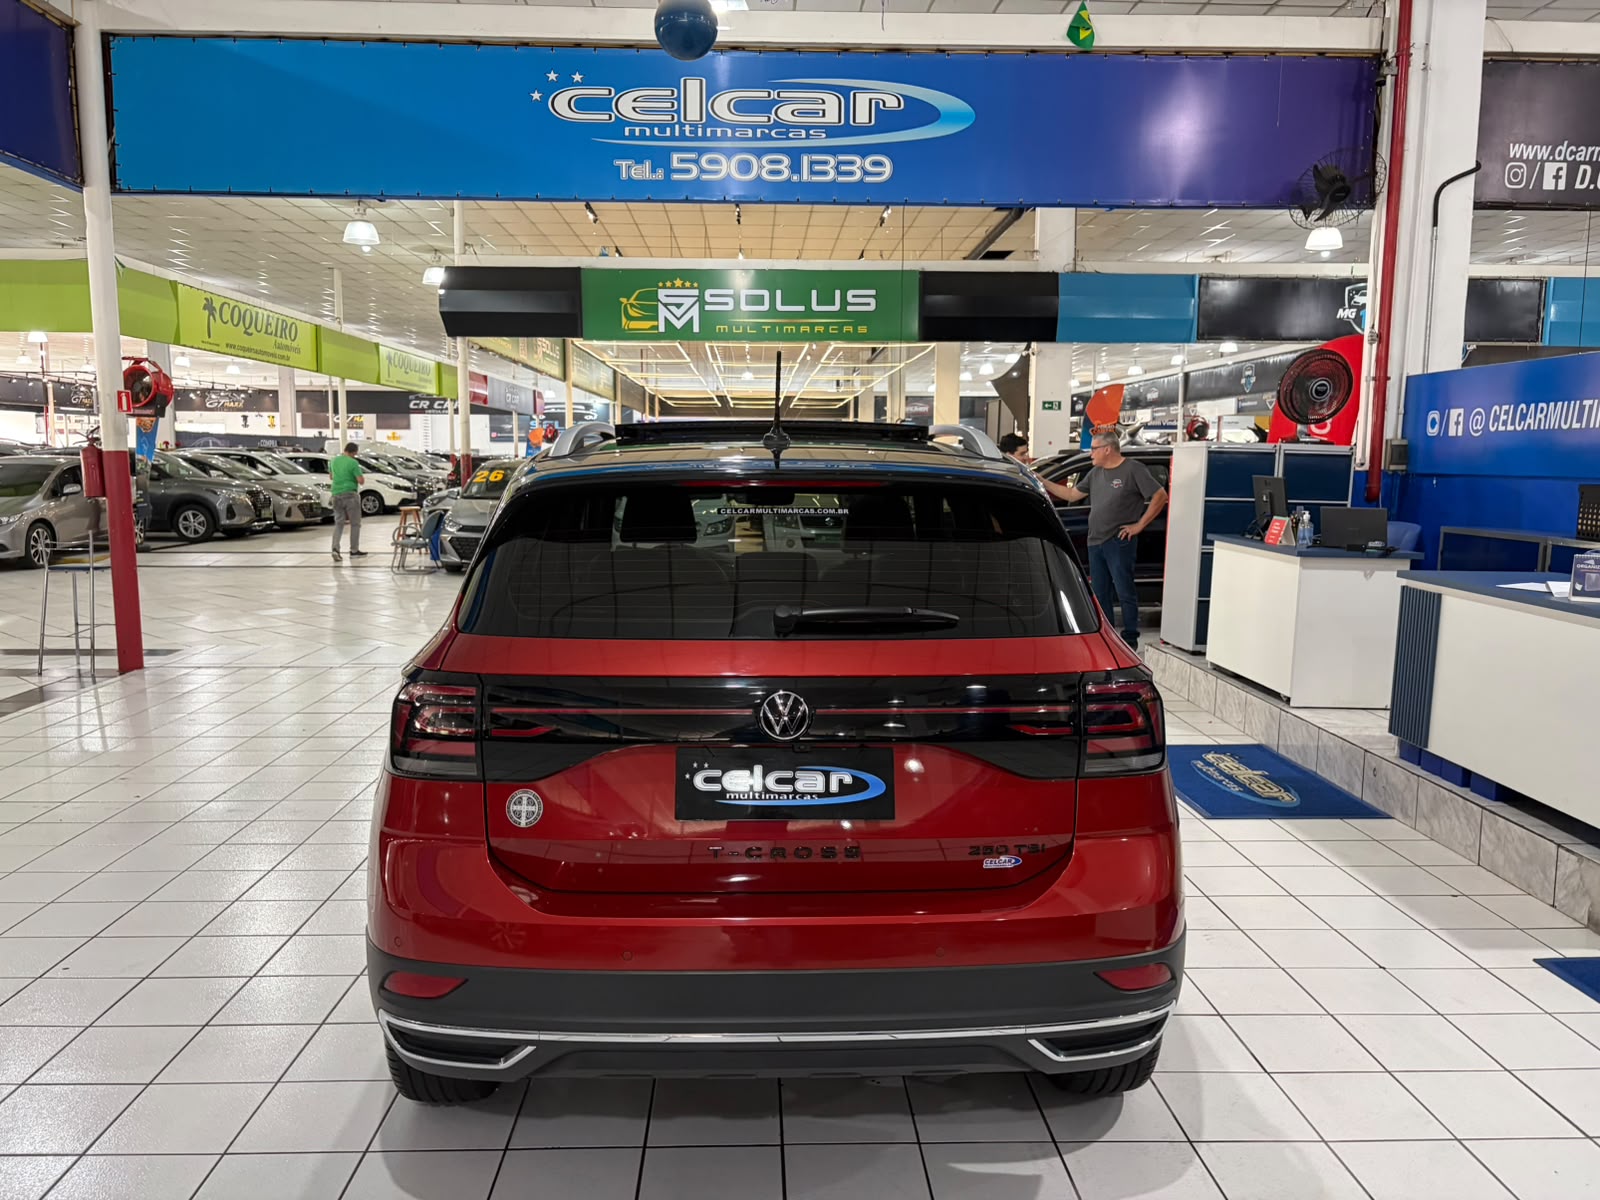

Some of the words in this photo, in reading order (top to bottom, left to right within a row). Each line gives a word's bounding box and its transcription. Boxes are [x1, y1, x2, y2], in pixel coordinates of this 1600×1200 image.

[548, 77, 905, 126] celcar
[624, 124, 827, 139] multimarcas
[670, 152, 894, 184] 5908.1339
[704, 289, 877, 312] SOLUS
[1336, 308, 1357, 319] MG
[218, 301, 299, 342] COQUEIRO
[716, 325, 868, 333] MULTIMARCAS
[409, 400, 430, 409] CR
[473, 470, 505, 483] 26
[692, 764, 853, 793] celcar
[726, 791, 819, 801] multimarcas
[708, 846, 861, 860] T-CROSS
